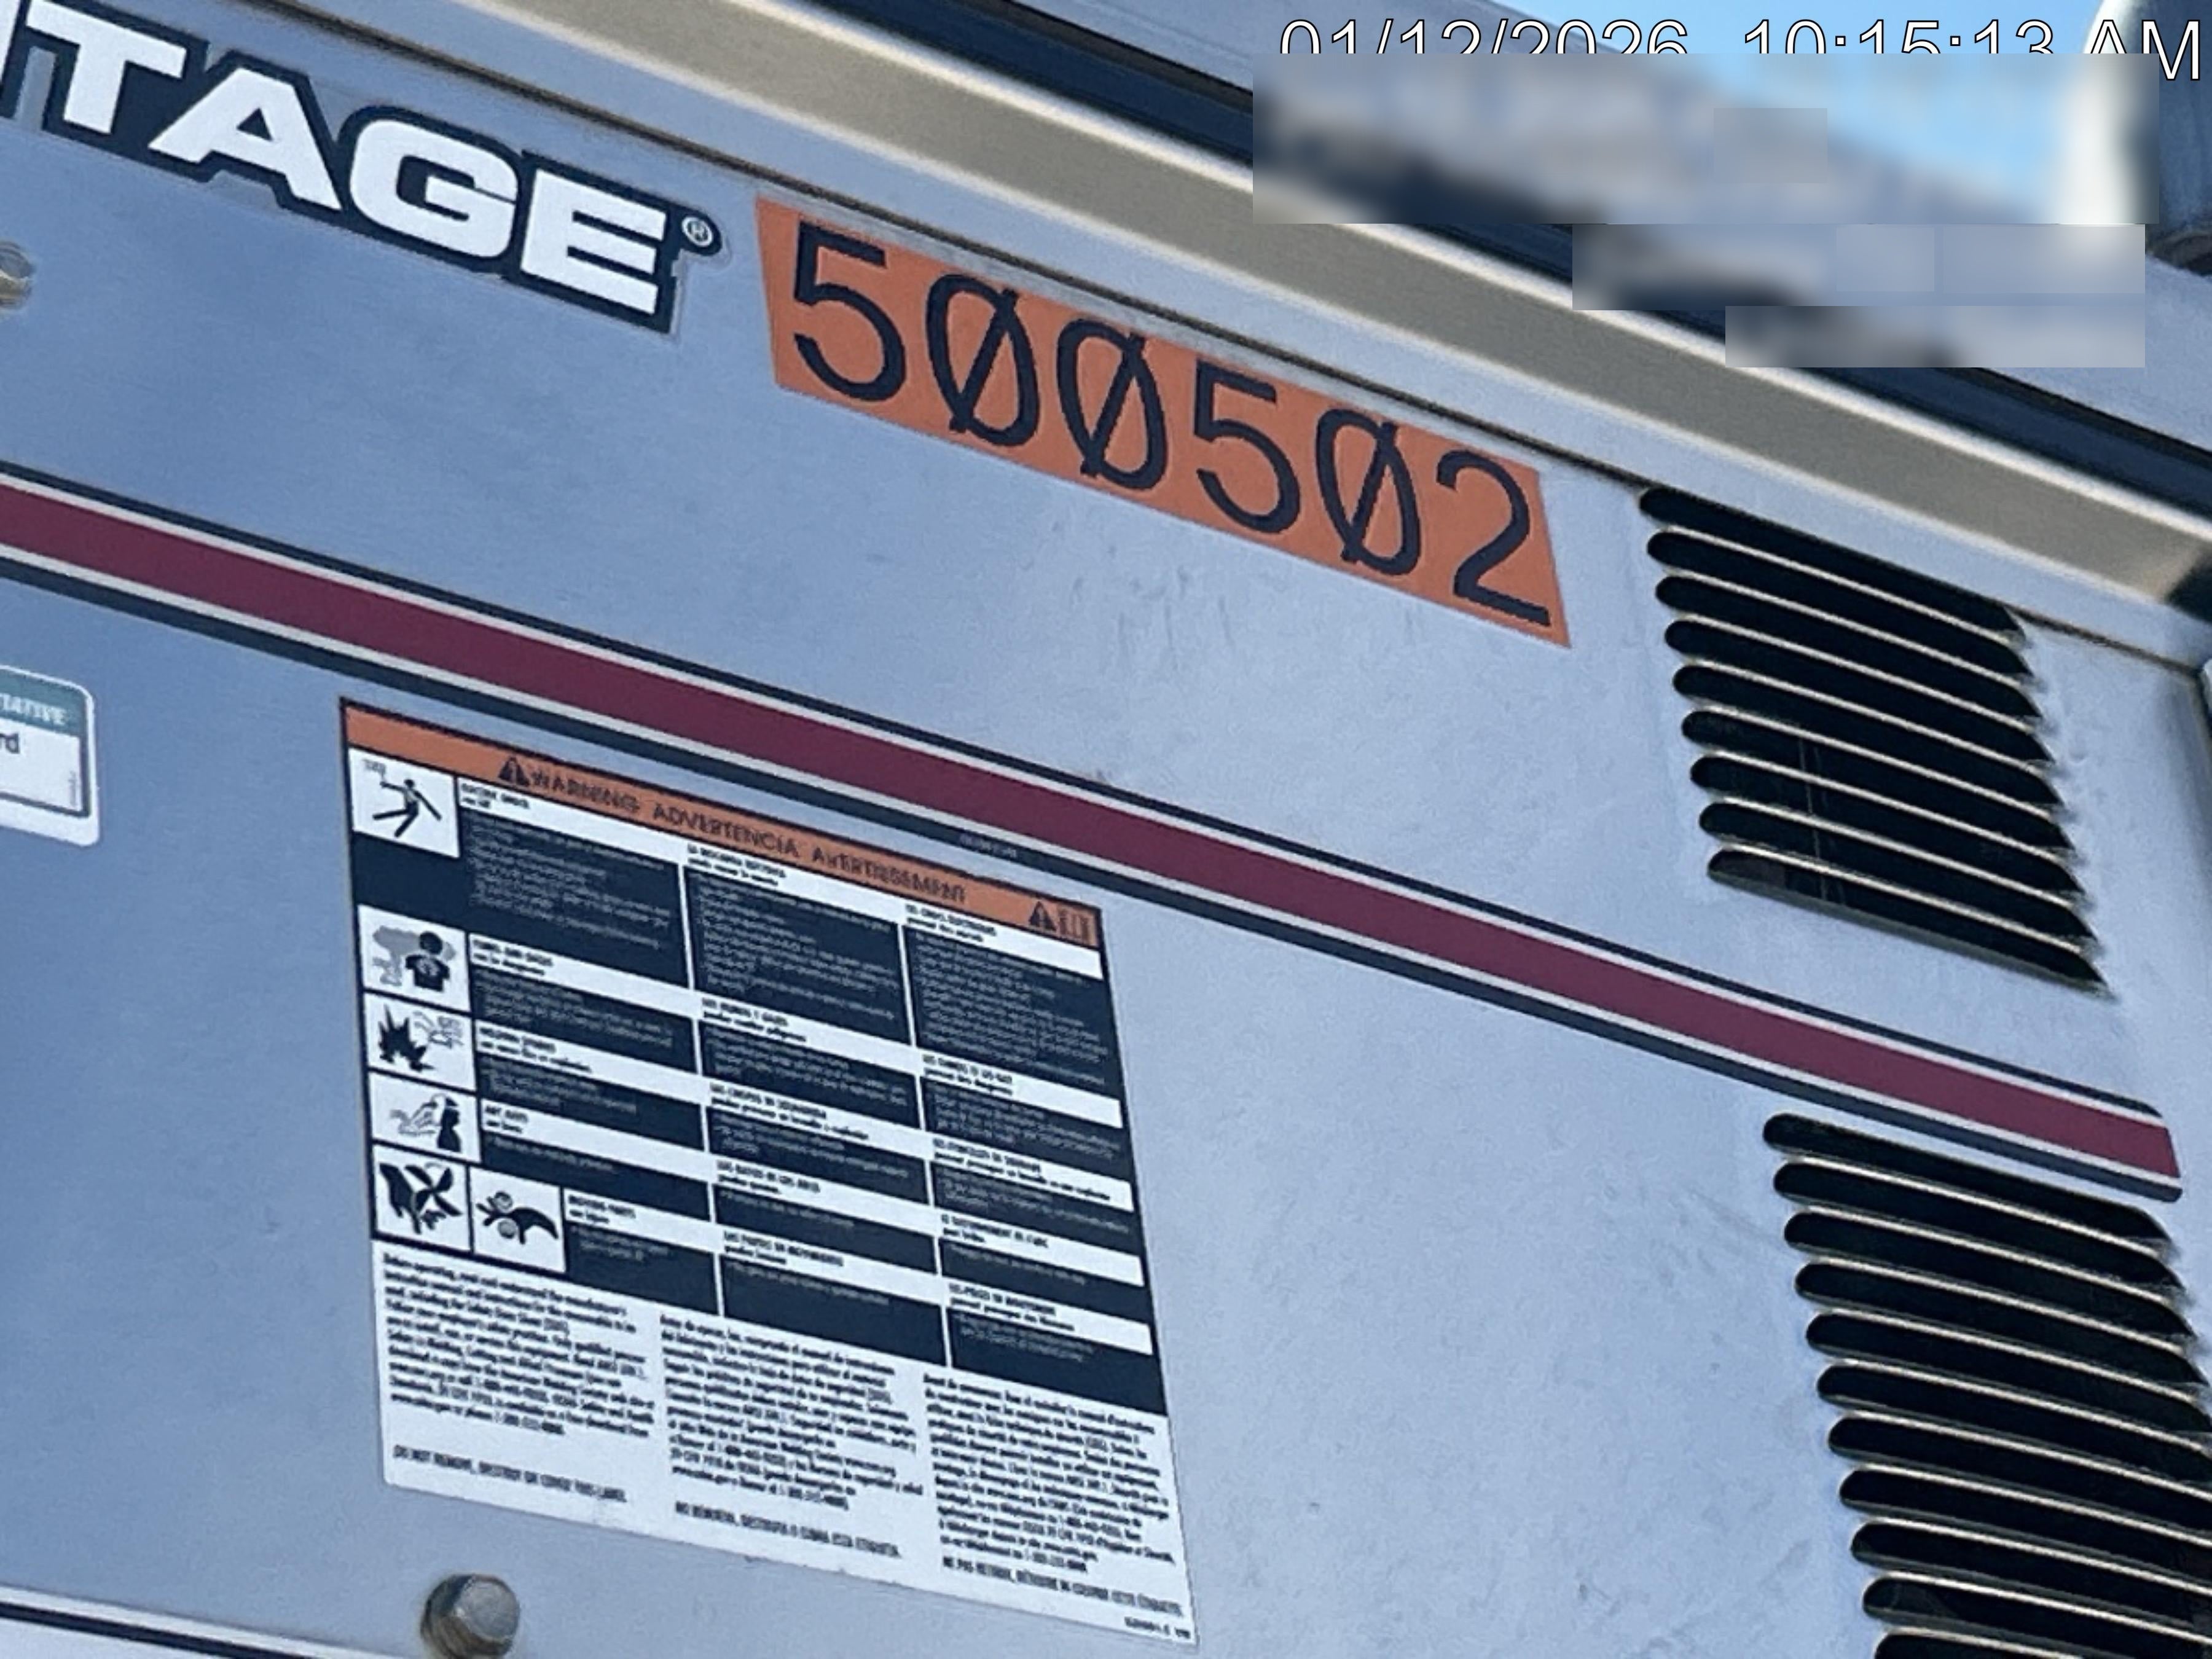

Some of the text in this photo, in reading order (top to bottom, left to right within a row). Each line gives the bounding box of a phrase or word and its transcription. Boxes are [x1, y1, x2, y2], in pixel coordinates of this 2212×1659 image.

[0, 0, 666, 315] TAGE
[793, 215, 1551, 627] 500502
[530, 770, 640, 814] WARNING
[653, 802, 800, 858] ADVERTENCIA
